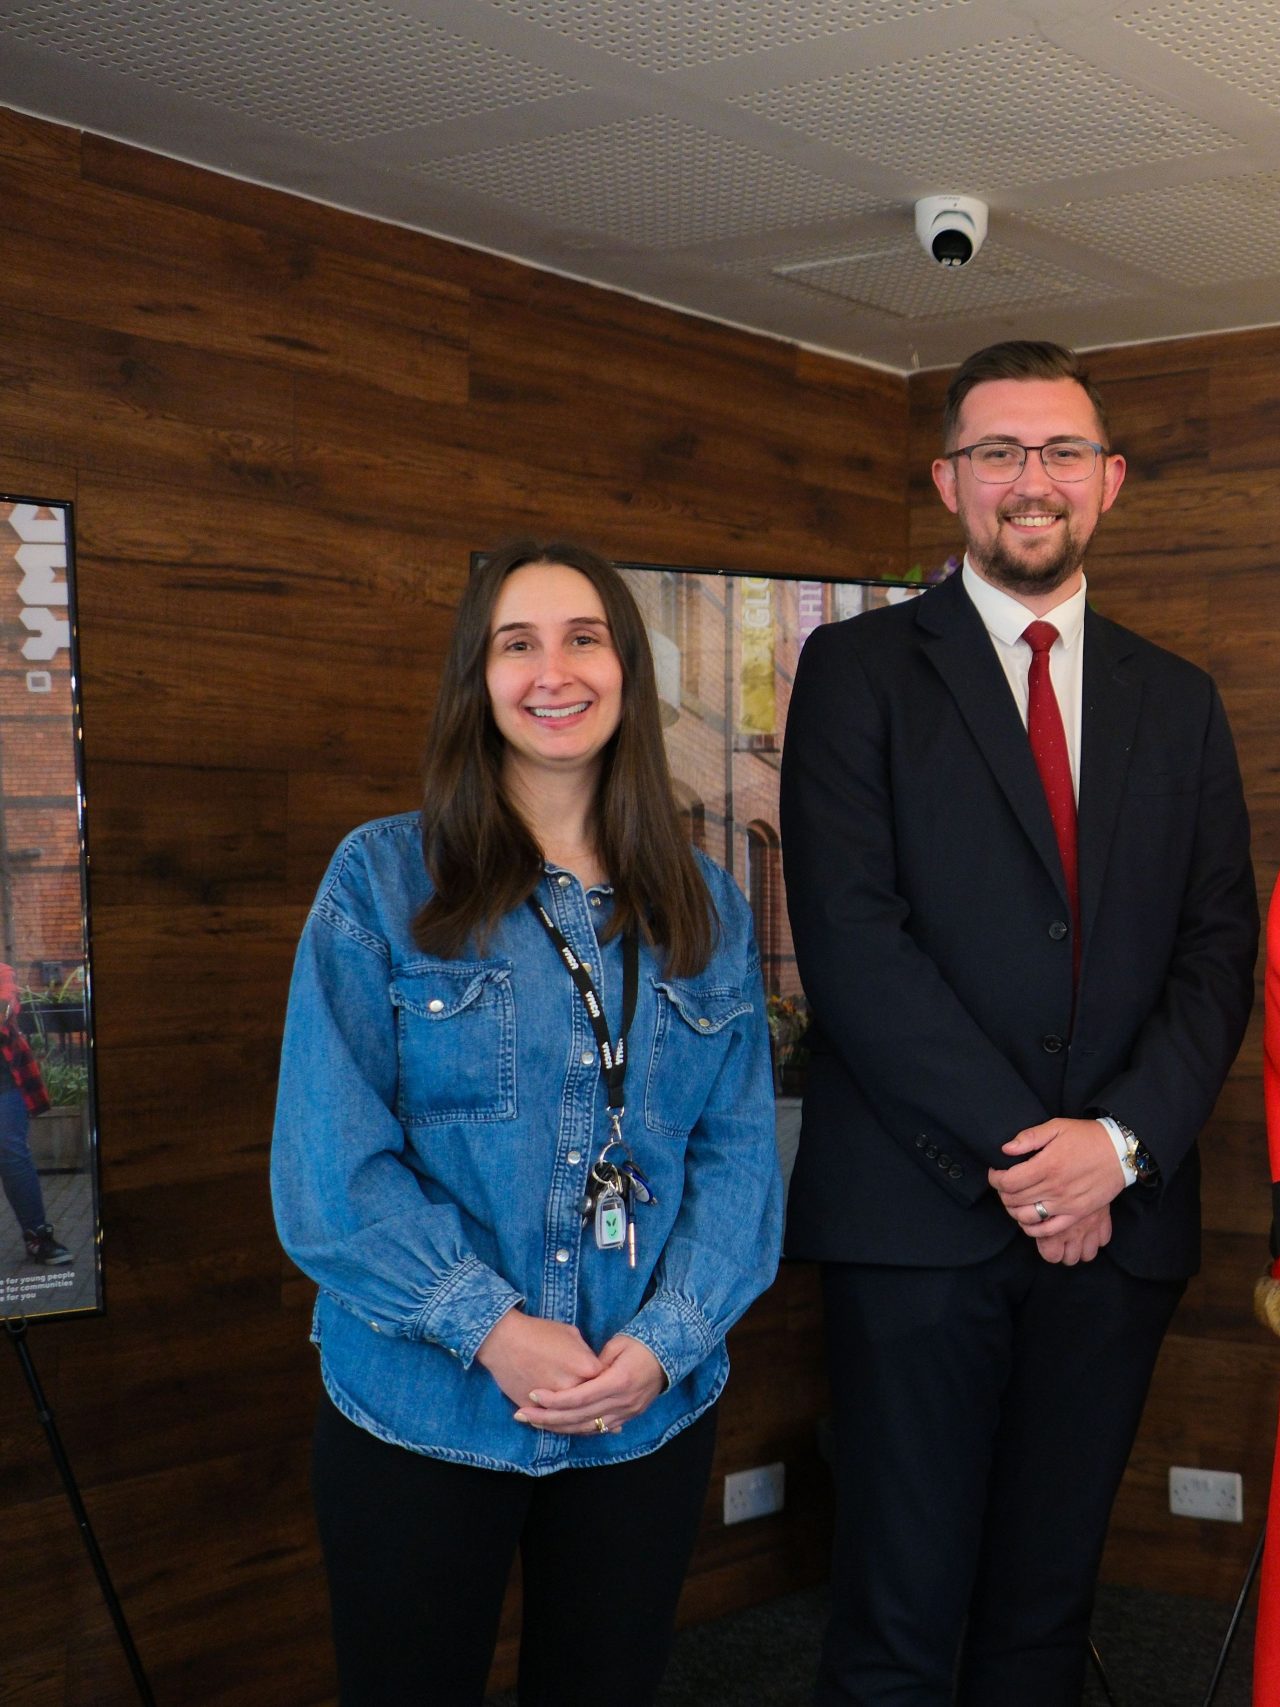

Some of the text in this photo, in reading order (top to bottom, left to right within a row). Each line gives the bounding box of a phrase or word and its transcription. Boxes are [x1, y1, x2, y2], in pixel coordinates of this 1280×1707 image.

[9, 503, 70, 660] YMC
[20, 1275, 46, 1284] young
[47, 1271, 75, 1281] people
[20, 1280, 73, 1291] communities
